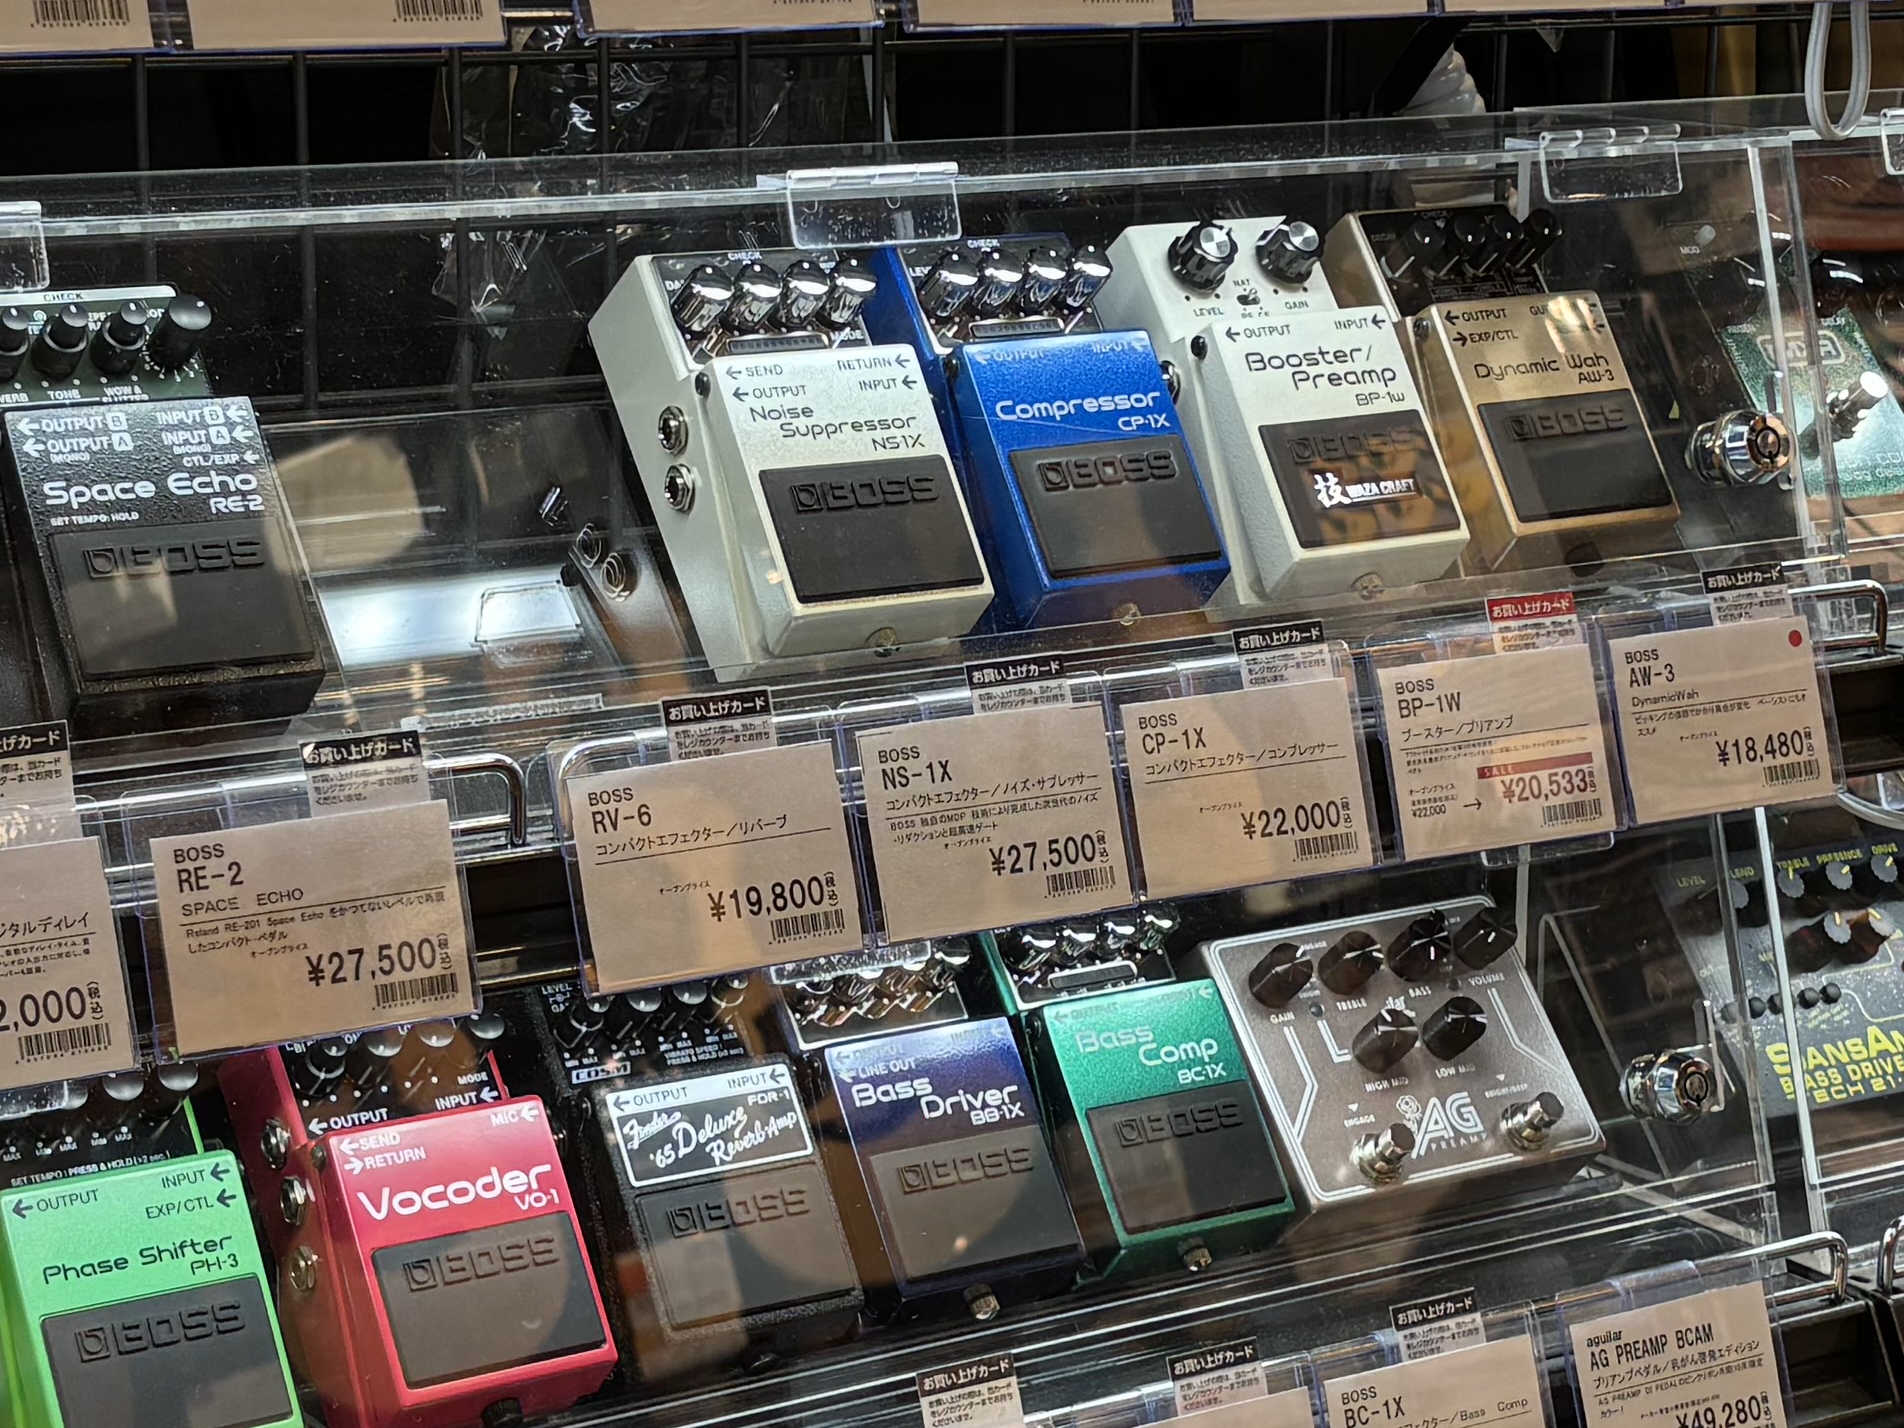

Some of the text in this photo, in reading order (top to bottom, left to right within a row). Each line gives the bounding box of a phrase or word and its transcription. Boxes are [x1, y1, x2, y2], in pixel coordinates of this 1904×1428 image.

[1291, 366, 1397, 390] Preamp
[750, 404, 813, 421] Noise
[995, 391, 1159, 421] Compressor
[781, 413, 917, 443] Suppressor
[43, 471, 258, 507] Space Echo
[210, 496, 263, 513] RE-2
[1630, 663, 1675, 686] AW-3
[1398, 691, 1462, 718] BP-1W
[1716, 731, 1804, 765] ¥18,480
[1501, 769, 1587, 804] ¥20,533
[592, 806, 652, 833] RV-6
[709, 876, 824, 922] ¥19,800
[850, 1078, 1018, 1120] Bass Driver
[356, 1163, 553, 1220] Vocoder
[43, 1233, 233, 1286] Phase Shifter
[190, 1255, 239, 1276] PH-3
[1590, 1324, 1714, 1370] AG PREAMP BCAM
